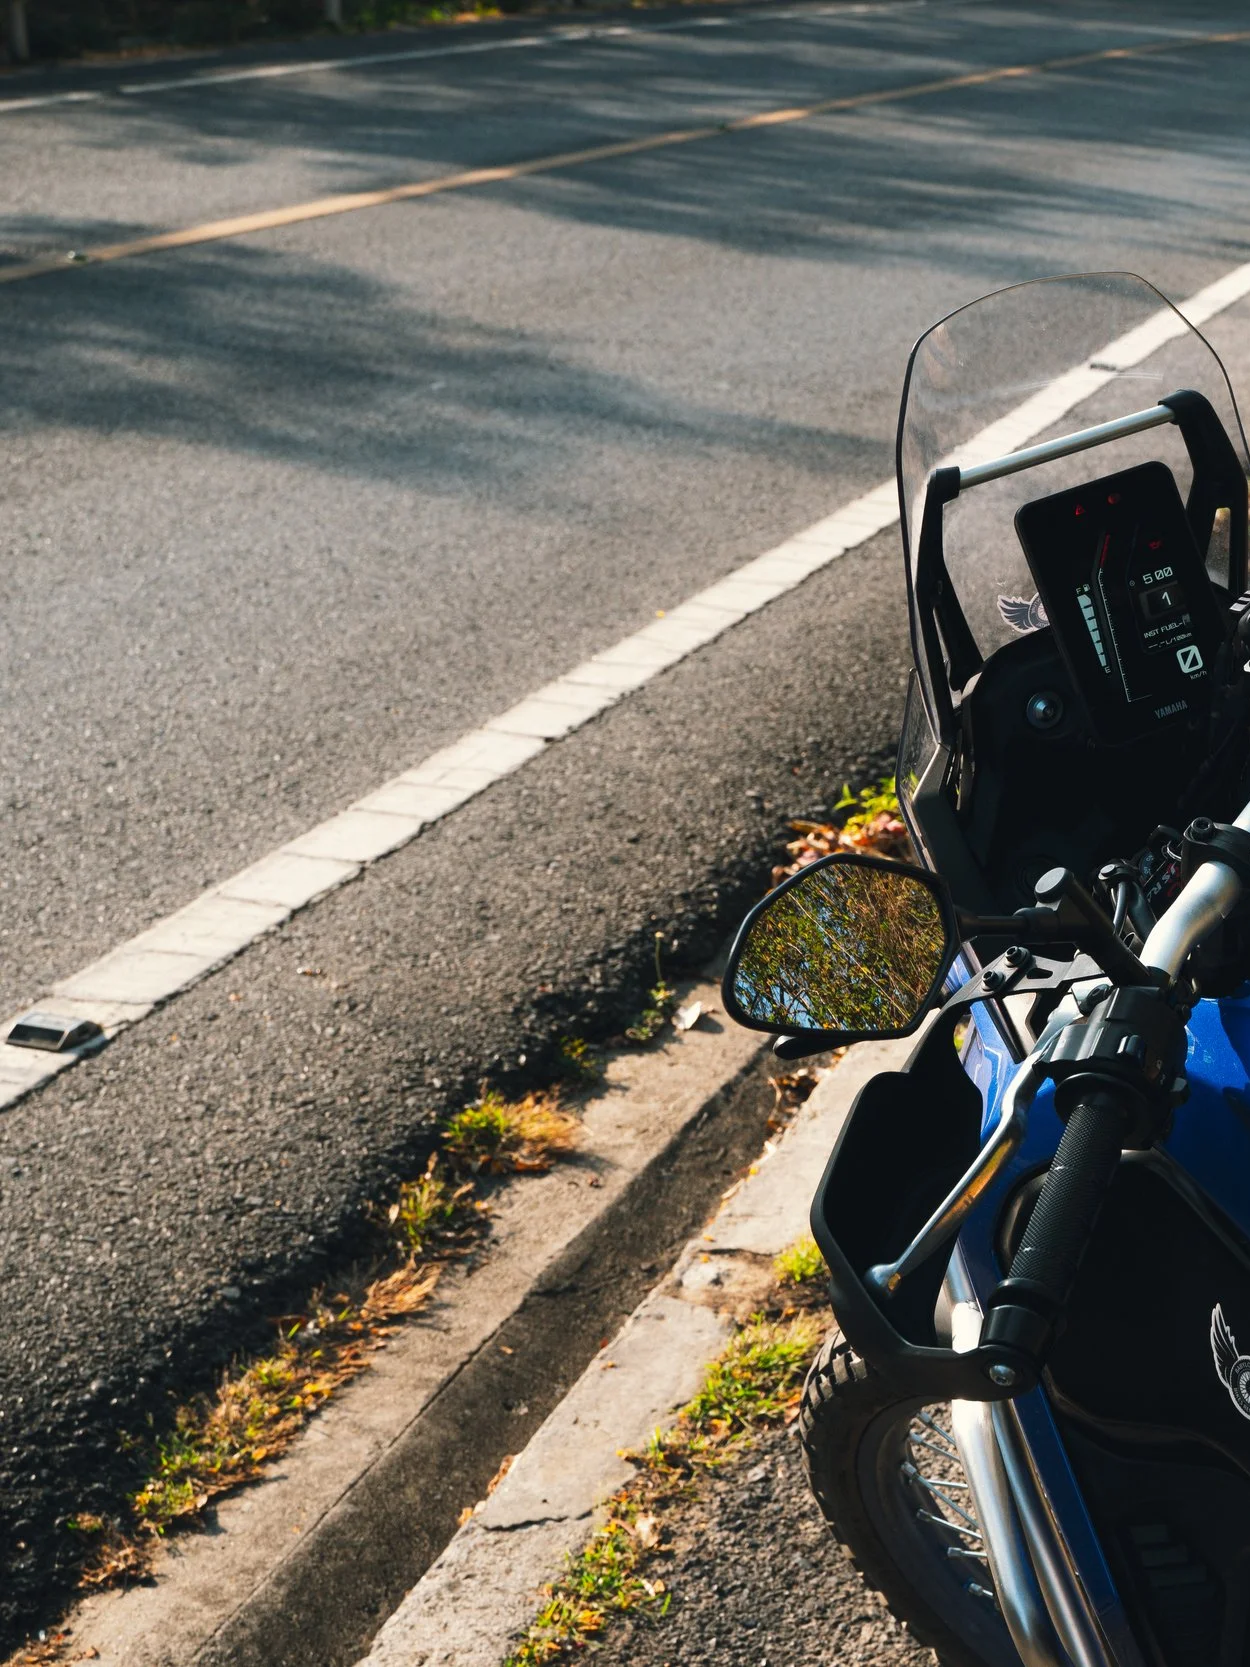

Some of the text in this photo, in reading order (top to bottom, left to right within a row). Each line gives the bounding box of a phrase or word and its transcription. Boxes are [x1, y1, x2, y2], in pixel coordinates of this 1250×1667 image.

[1161, 591, 1171, 606] 1
[1176, 644, 1203, 674] 0
[1154, 699, 1188, 719] YAMAHA
